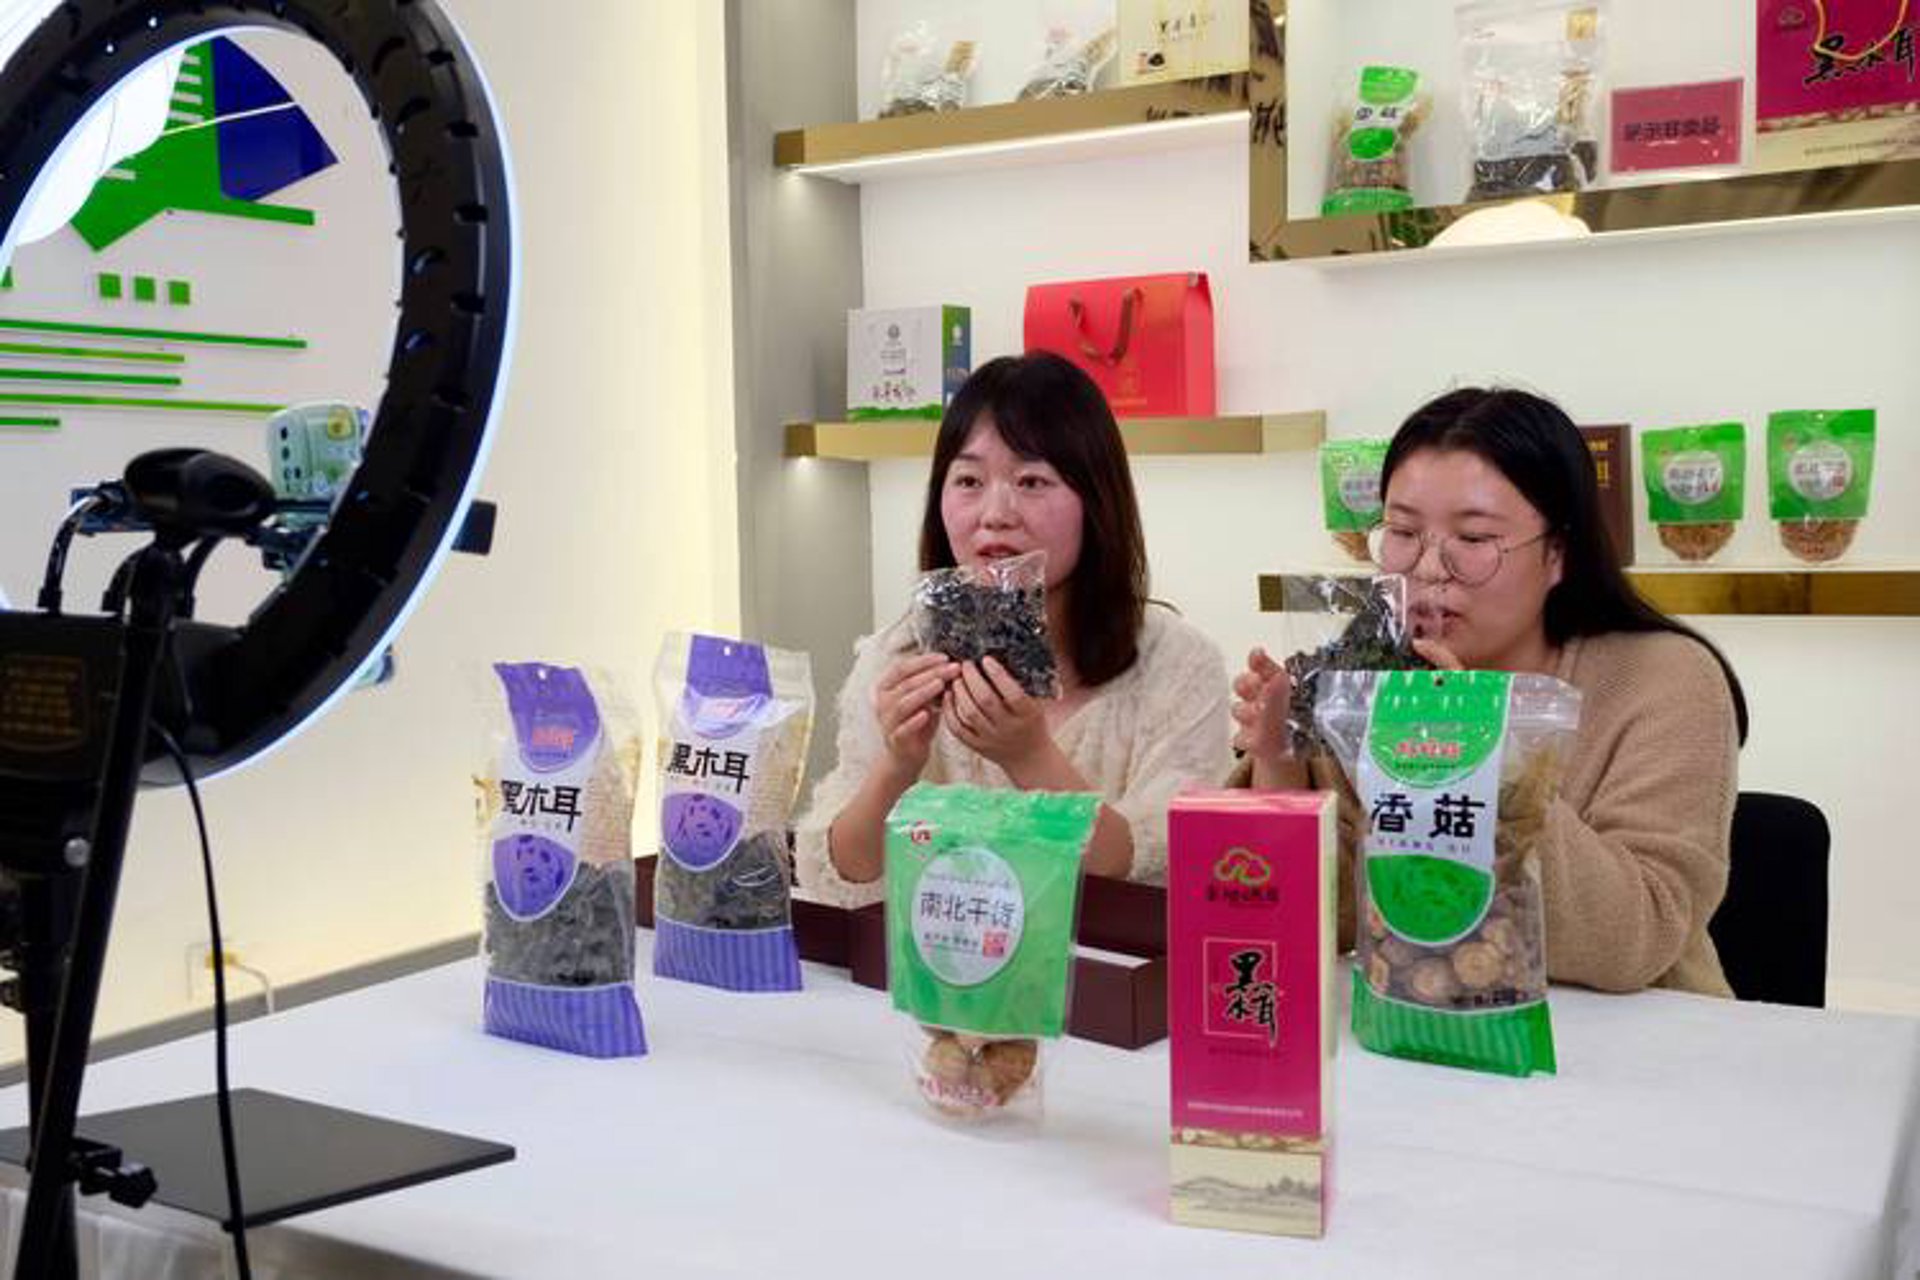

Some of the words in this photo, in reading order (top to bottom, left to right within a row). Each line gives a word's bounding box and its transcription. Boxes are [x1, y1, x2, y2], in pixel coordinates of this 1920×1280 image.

[667, 742, 750, 793] 黑木耳
[501, 780, 582, 833] 黑木耳
[1371, 793, 1486, 838] 香菇
